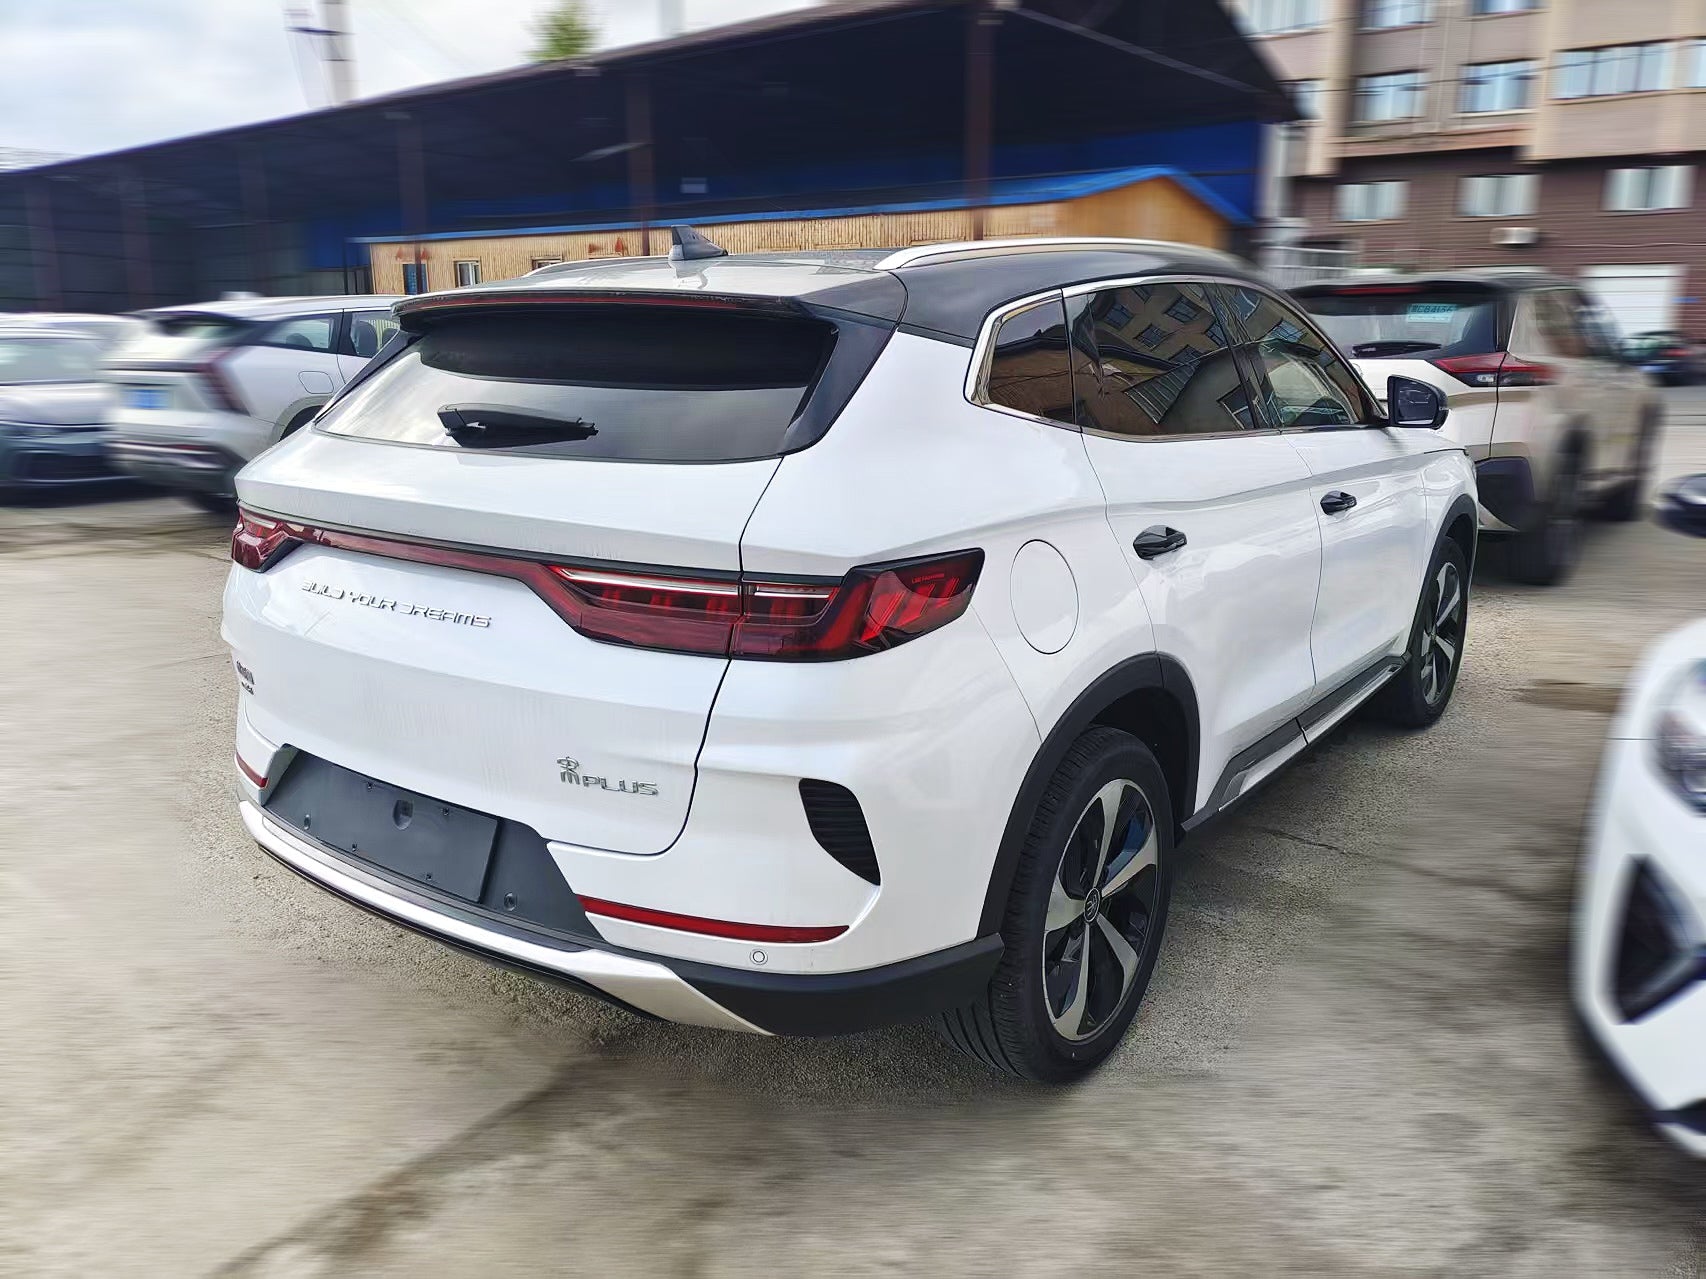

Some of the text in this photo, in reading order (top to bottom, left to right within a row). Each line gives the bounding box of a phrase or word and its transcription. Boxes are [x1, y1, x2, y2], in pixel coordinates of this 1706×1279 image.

[302, 579, 492, 628] BUILD YOUR DREAMS
[582, 775, 659, 796] PLUS
